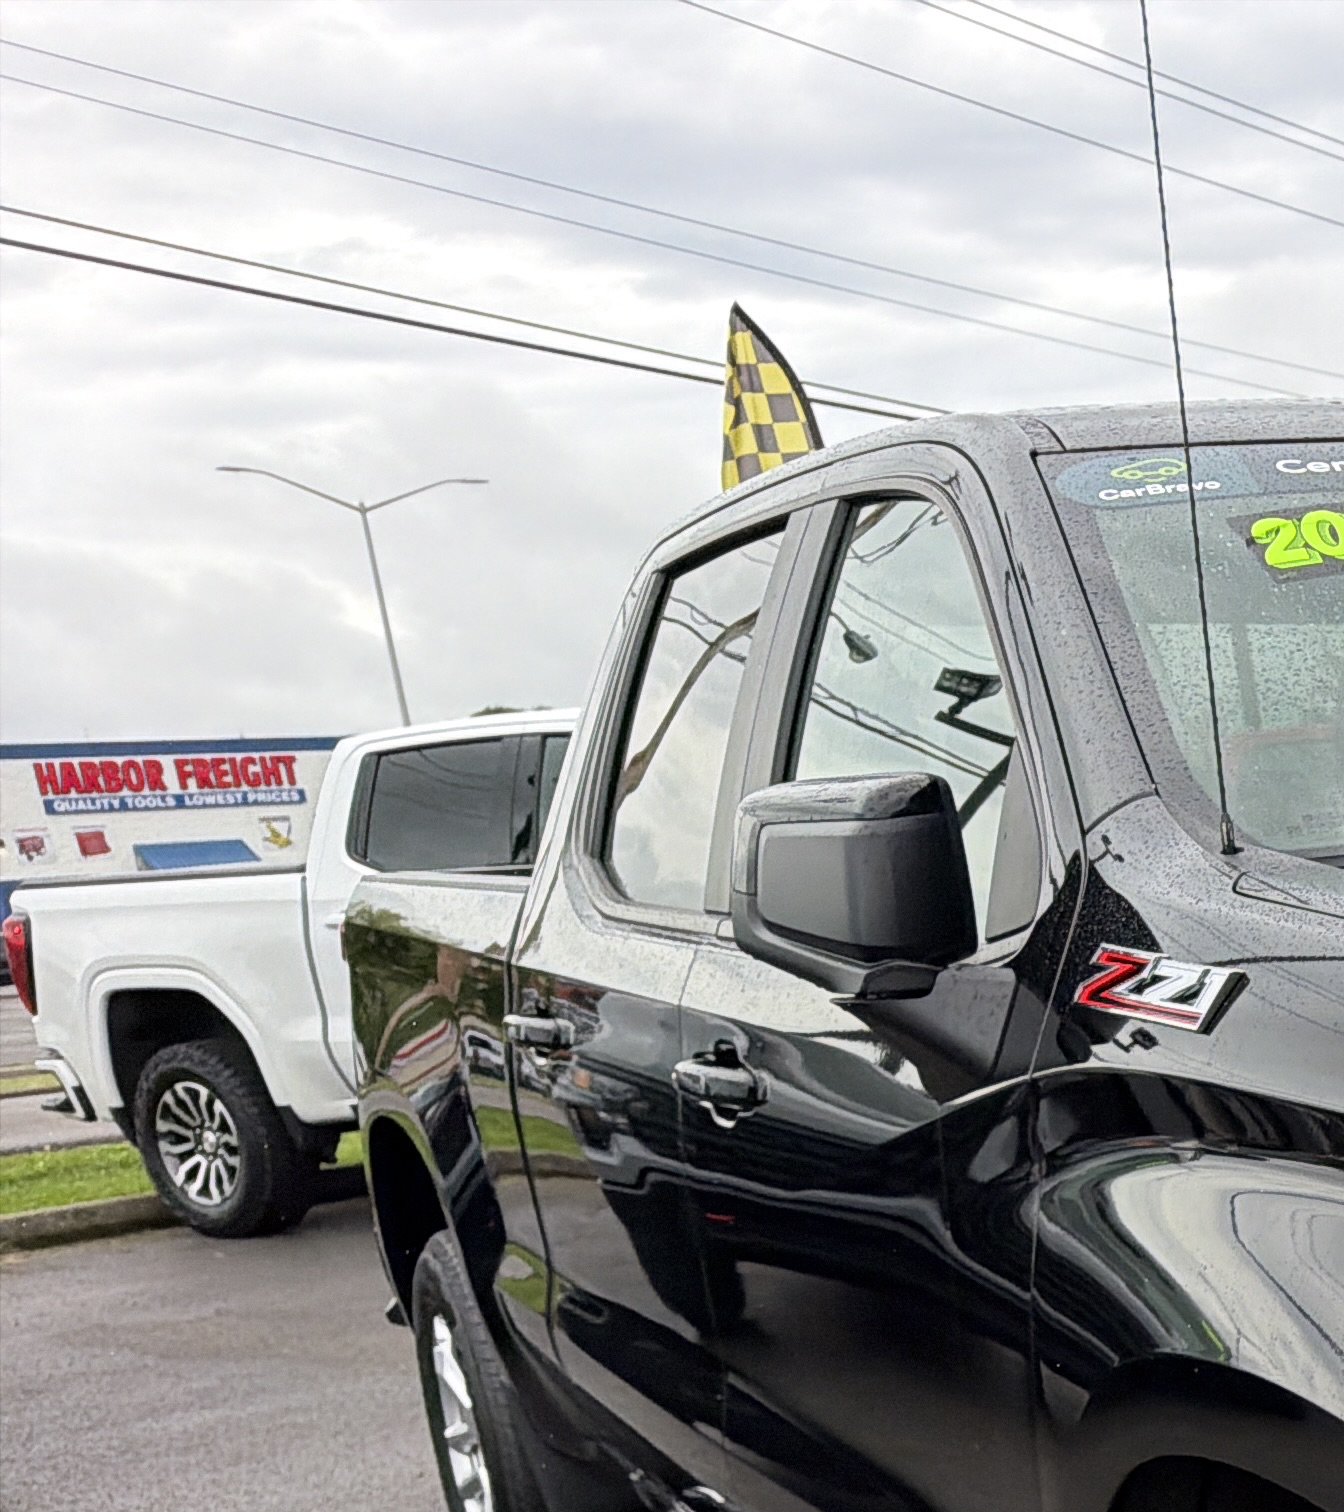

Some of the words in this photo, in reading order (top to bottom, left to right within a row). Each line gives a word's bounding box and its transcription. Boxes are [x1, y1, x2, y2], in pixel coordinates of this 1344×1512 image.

[1098, 480, 1221, 501] CarBravo
[33, 759, 168, 796] HARBOR
[173, 755, 299, 790] FREIGHT
[53, 798, 121, 812] QUALITY
[124, 795, 177, 809] TOOLS
[184, 793, 244, 806] LOWEST
[247, 789, 300, 803] PRICES
[1074, 943, 1249, 1034] Z71
